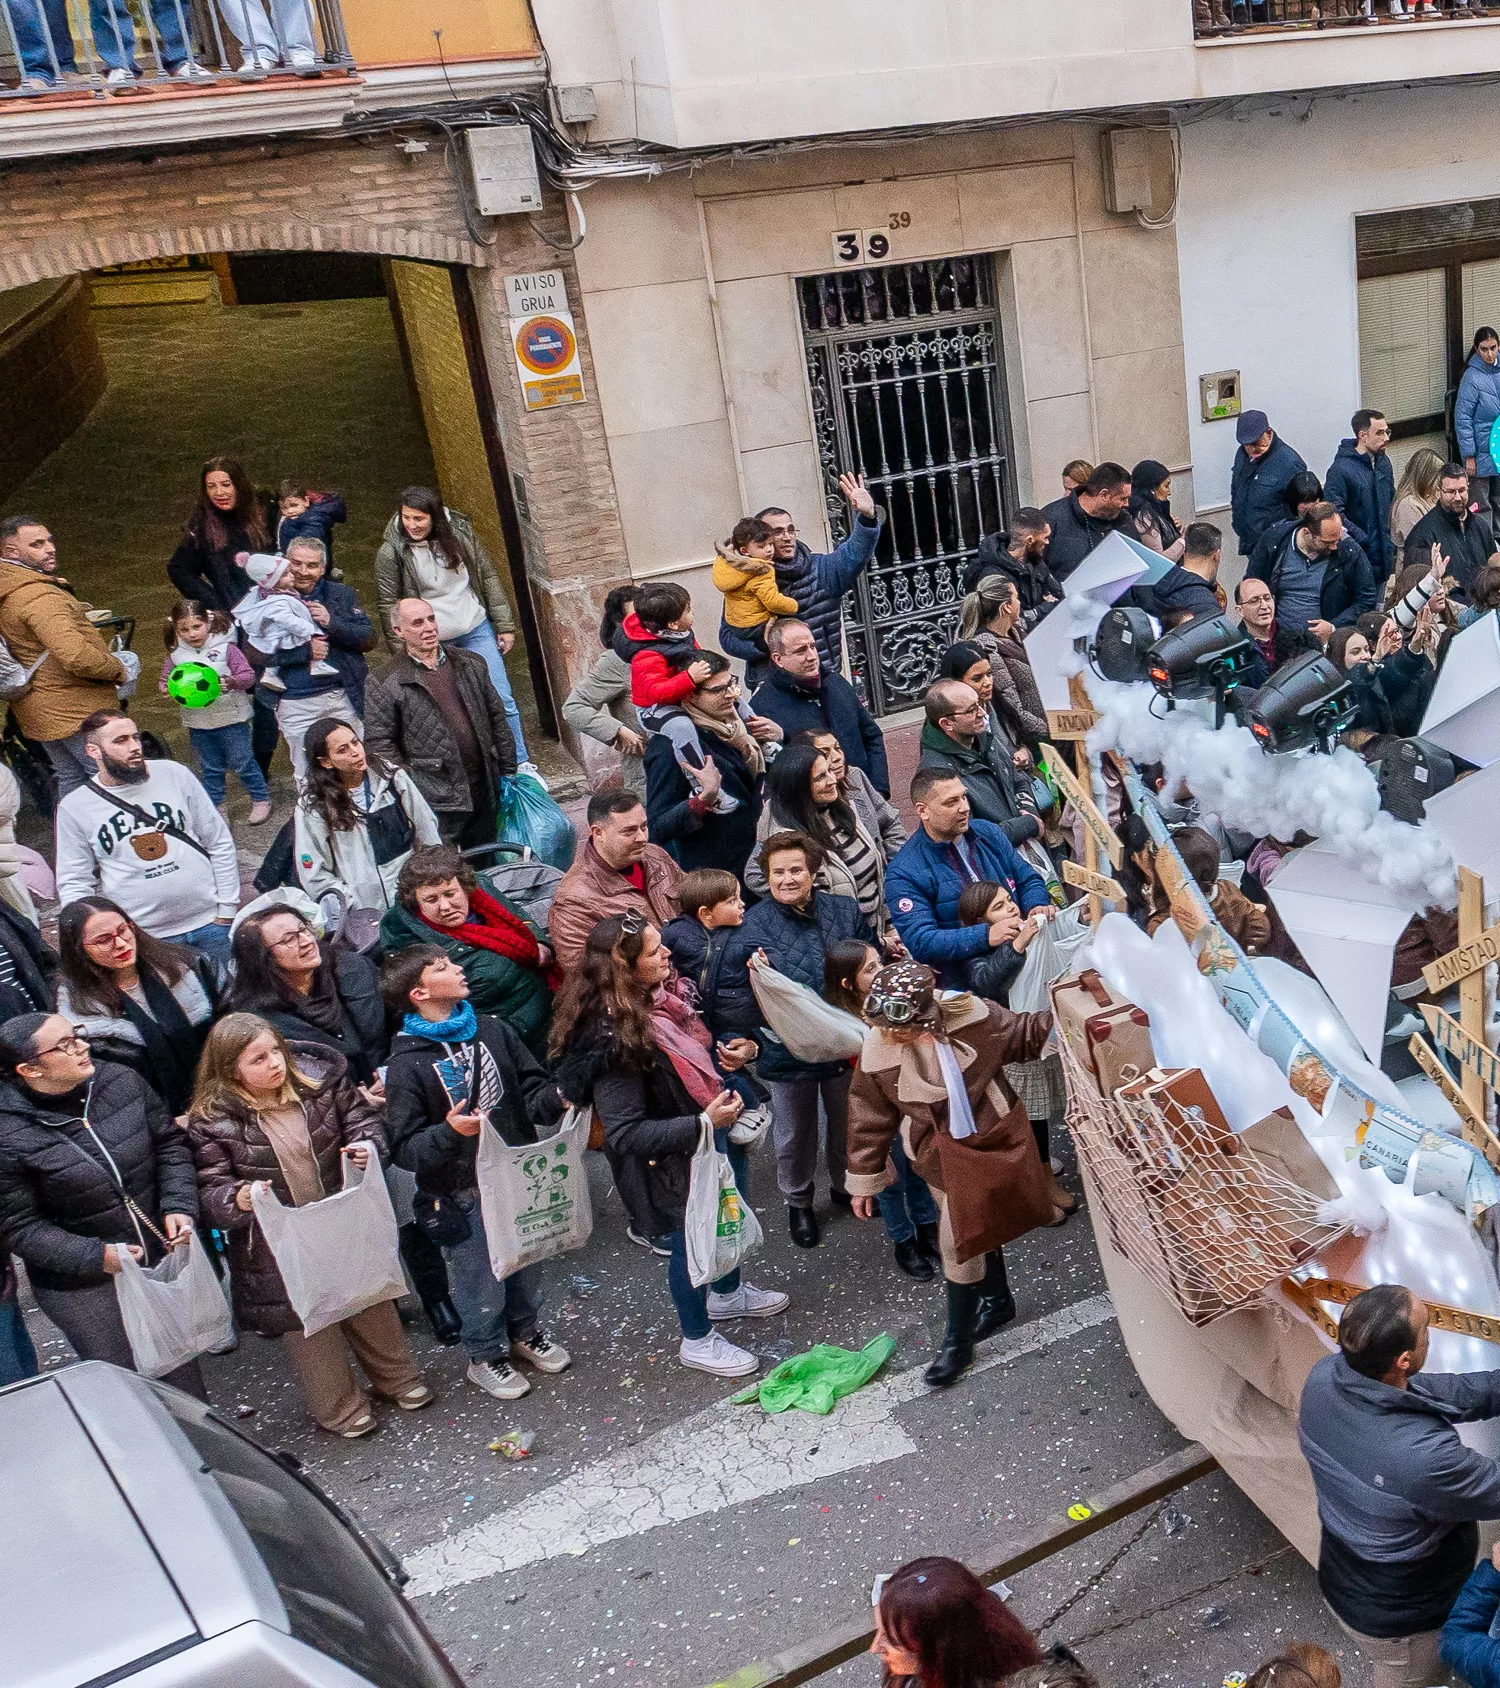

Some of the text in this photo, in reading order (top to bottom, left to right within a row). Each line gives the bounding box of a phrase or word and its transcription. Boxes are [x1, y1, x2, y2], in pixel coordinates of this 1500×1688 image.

[888, 211, 911, 230] 39
[837, 233, 889, 261] 39
[514, 273, 556, 293] AVISO
[521, 295, 555, 312] GRUA
[1437, 937, 1497, 985] AMISTAD
